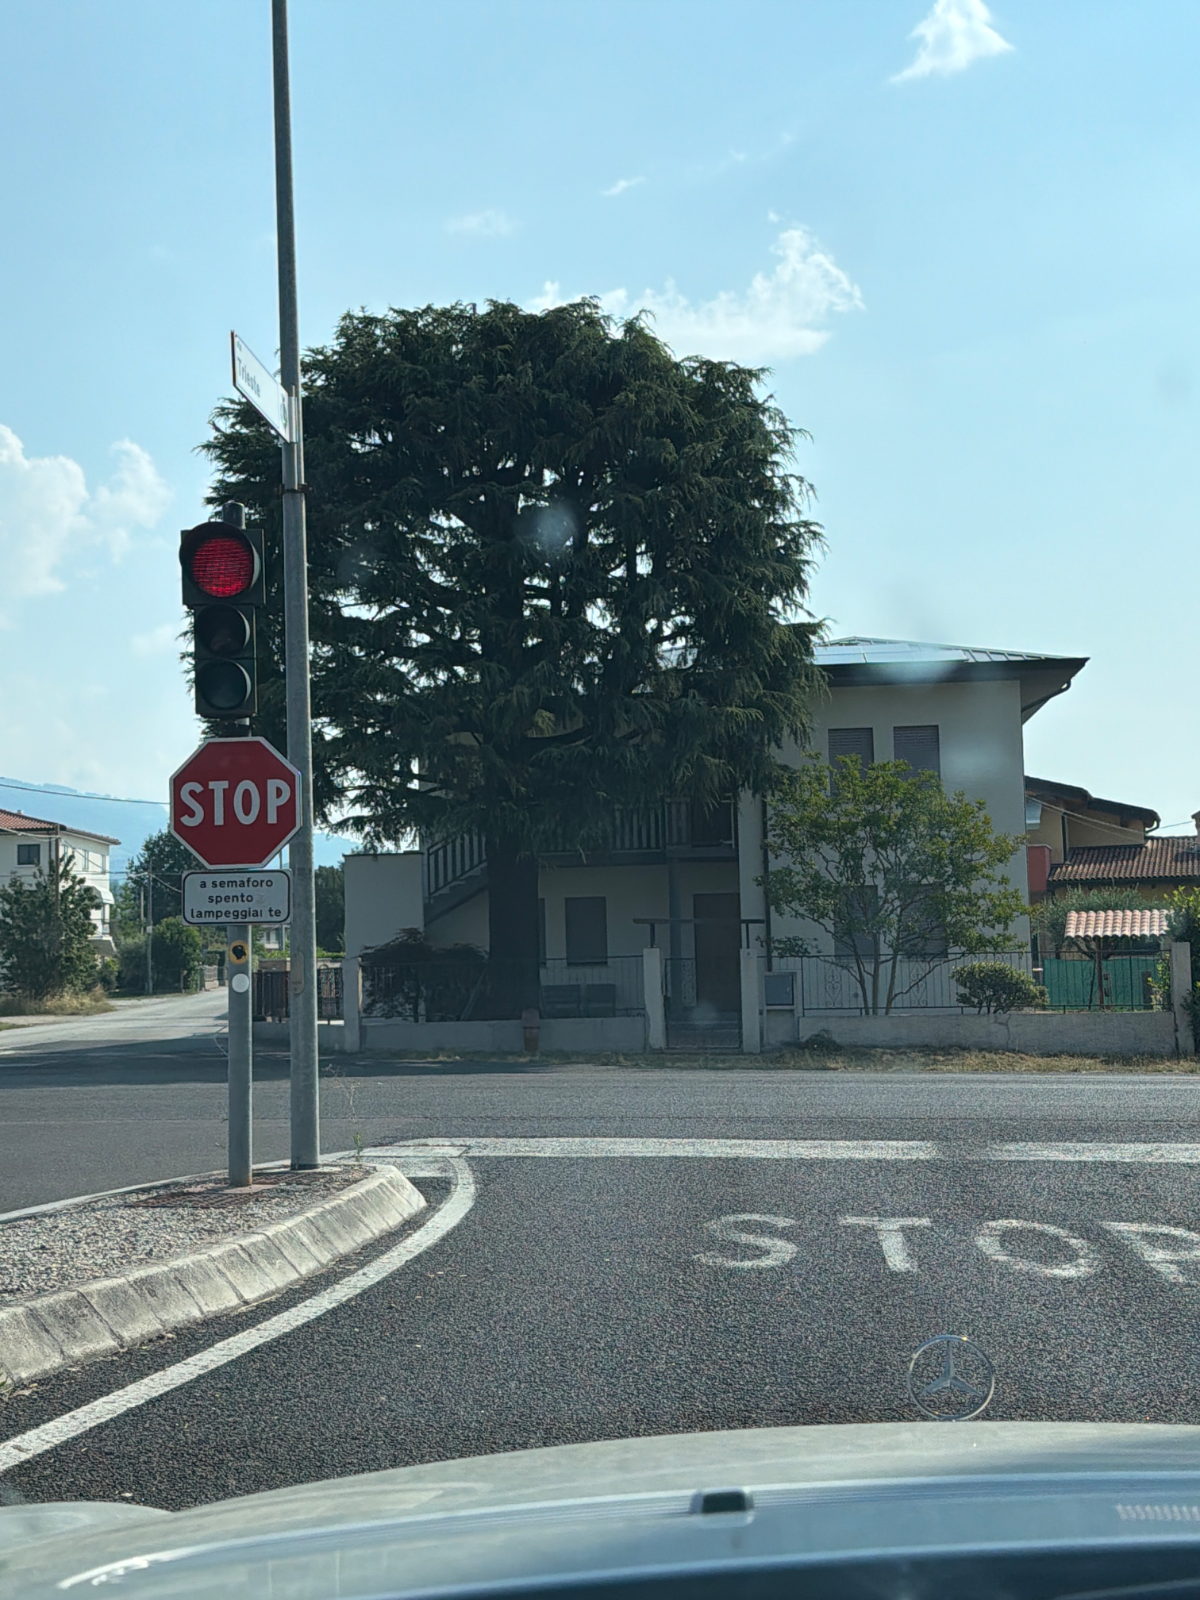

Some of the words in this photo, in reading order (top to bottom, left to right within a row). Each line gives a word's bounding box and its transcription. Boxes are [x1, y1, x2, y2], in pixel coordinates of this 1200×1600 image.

[180, 779, 291, 827] STOP
[199, 880, 207, 889] a
[211, 876, 274, 889] semaforo
[207, 893, 254, 905] spento
[695, 1213, 1200, 1283] STOP
